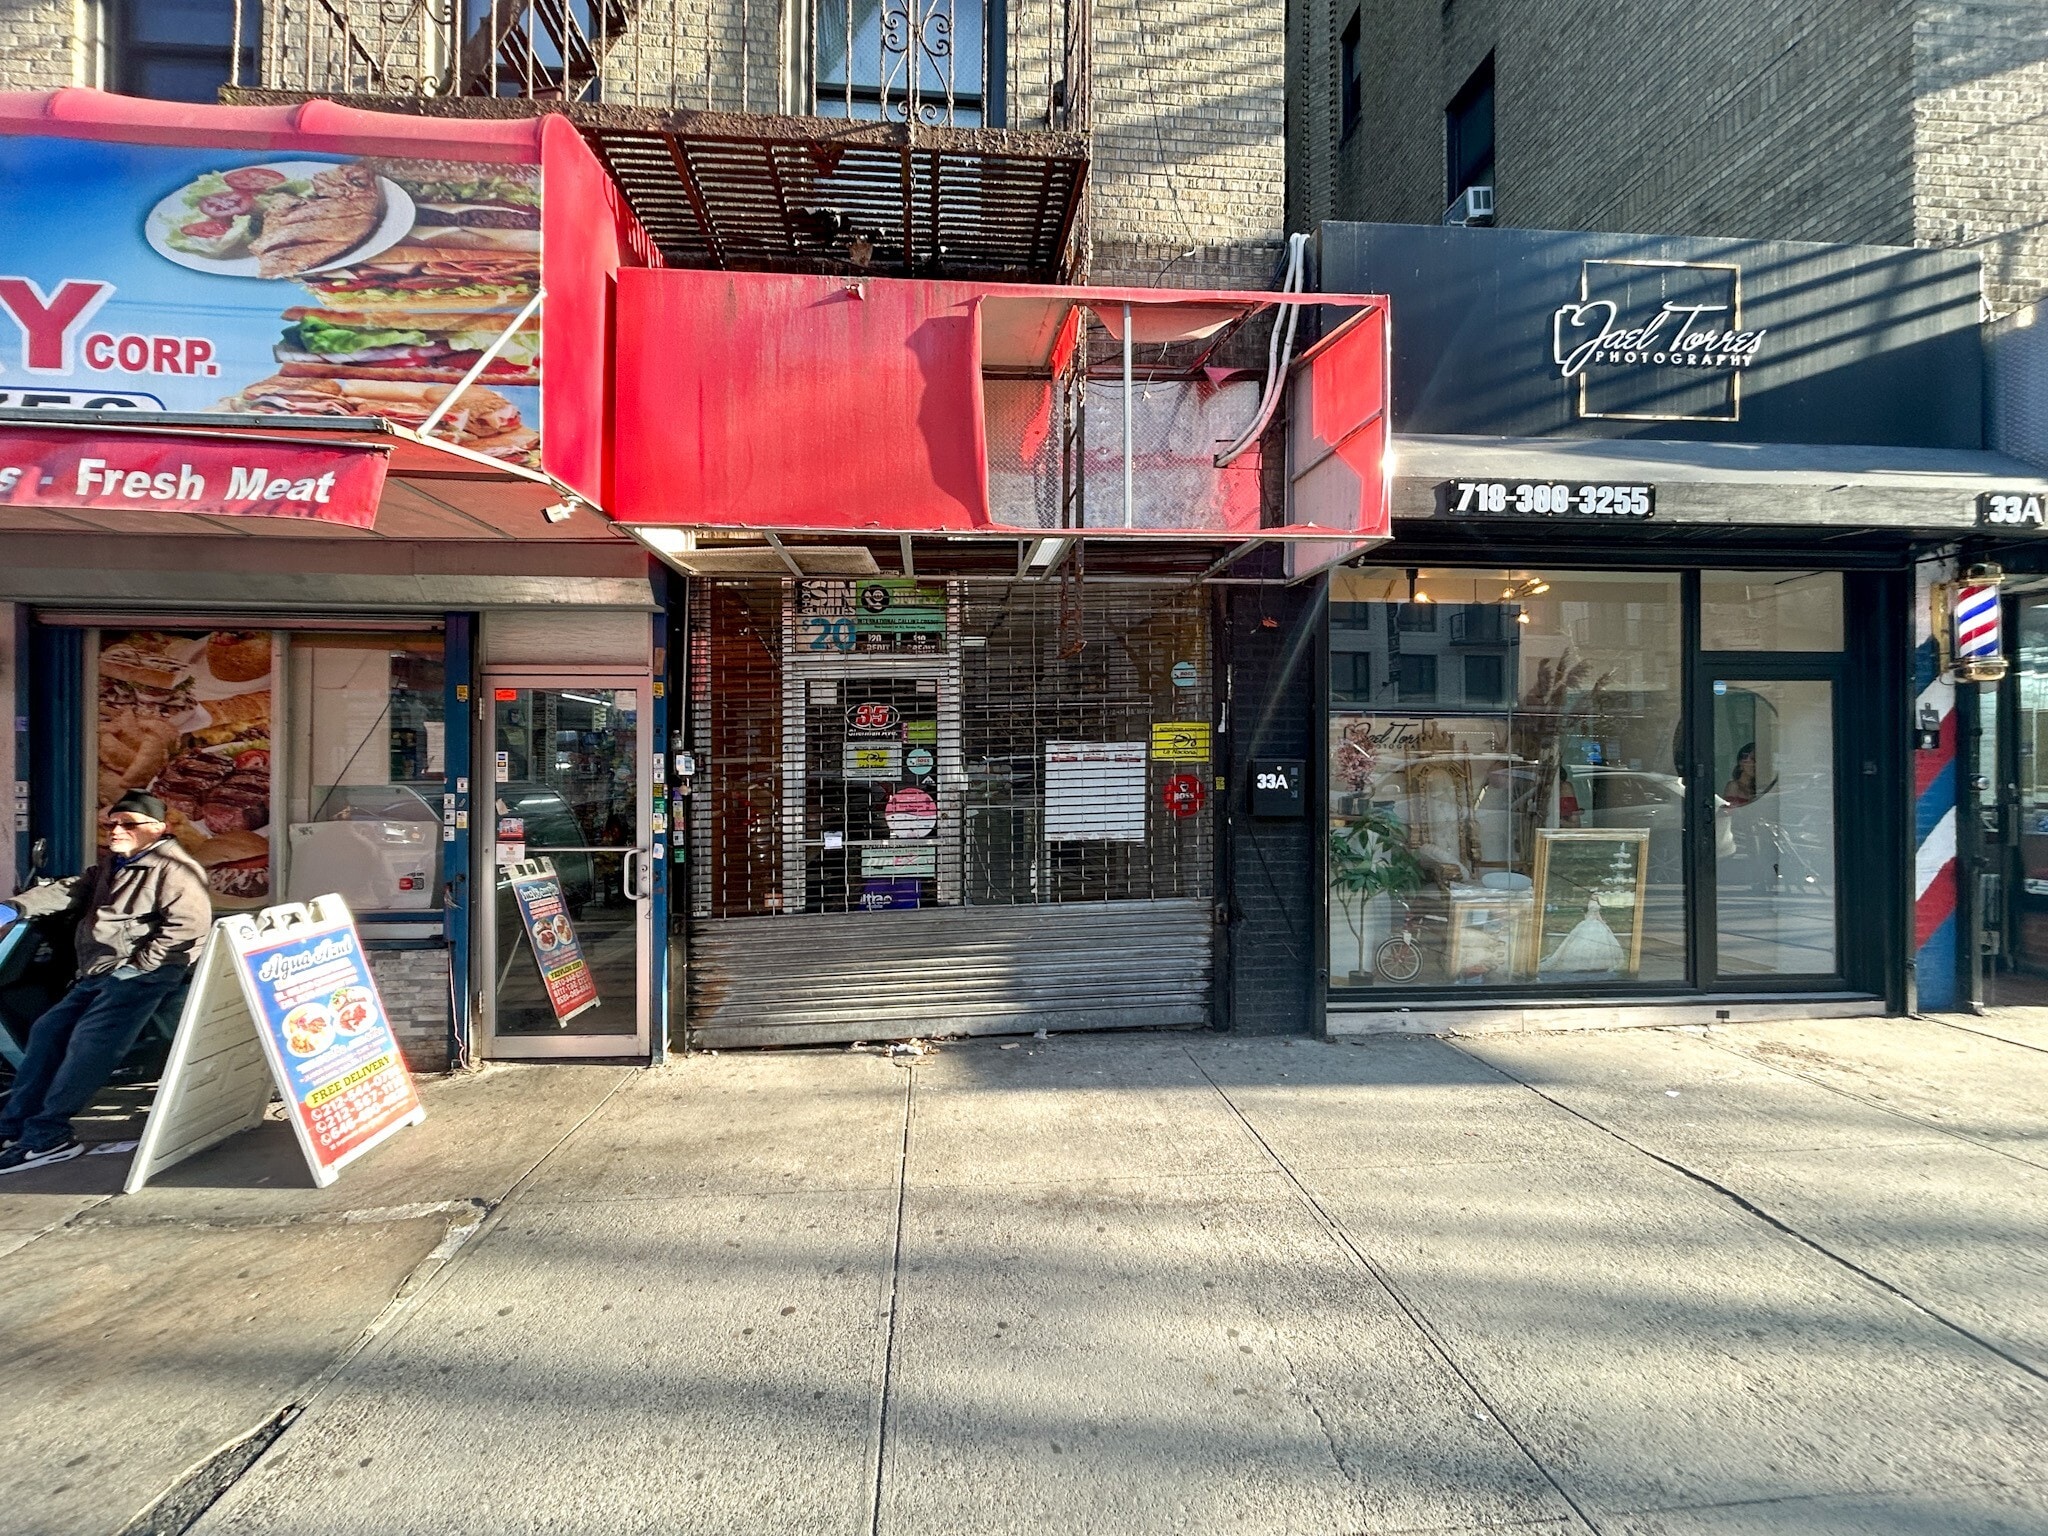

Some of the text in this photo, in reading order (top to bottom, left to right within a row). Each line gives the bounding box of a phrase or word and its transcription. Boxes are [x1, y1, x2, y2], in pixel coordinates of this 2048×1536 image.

[1561, 301, 1767, 377] Jael Torres
[86, 336, 219, 376] CORP.
[1595, 351, 1754, 367] PHOTOGRAPHY
[76, 458, 205, 501] Fresh
[225, 466, 335, 503] Meat
[1456, 483, 1650, 514] 718-300-3255
[1989, 495, 2043, 523] 33A
[811, 580, 857, 607] SIN
[802, 617, 857, 650] $20
[856, 705, 890, 728] 35
[1257, 773, 1289, 789] 33A
[261, 953, 311, 980] Agua
[311, 1055, 390, 1104] FREE DELIVERY
